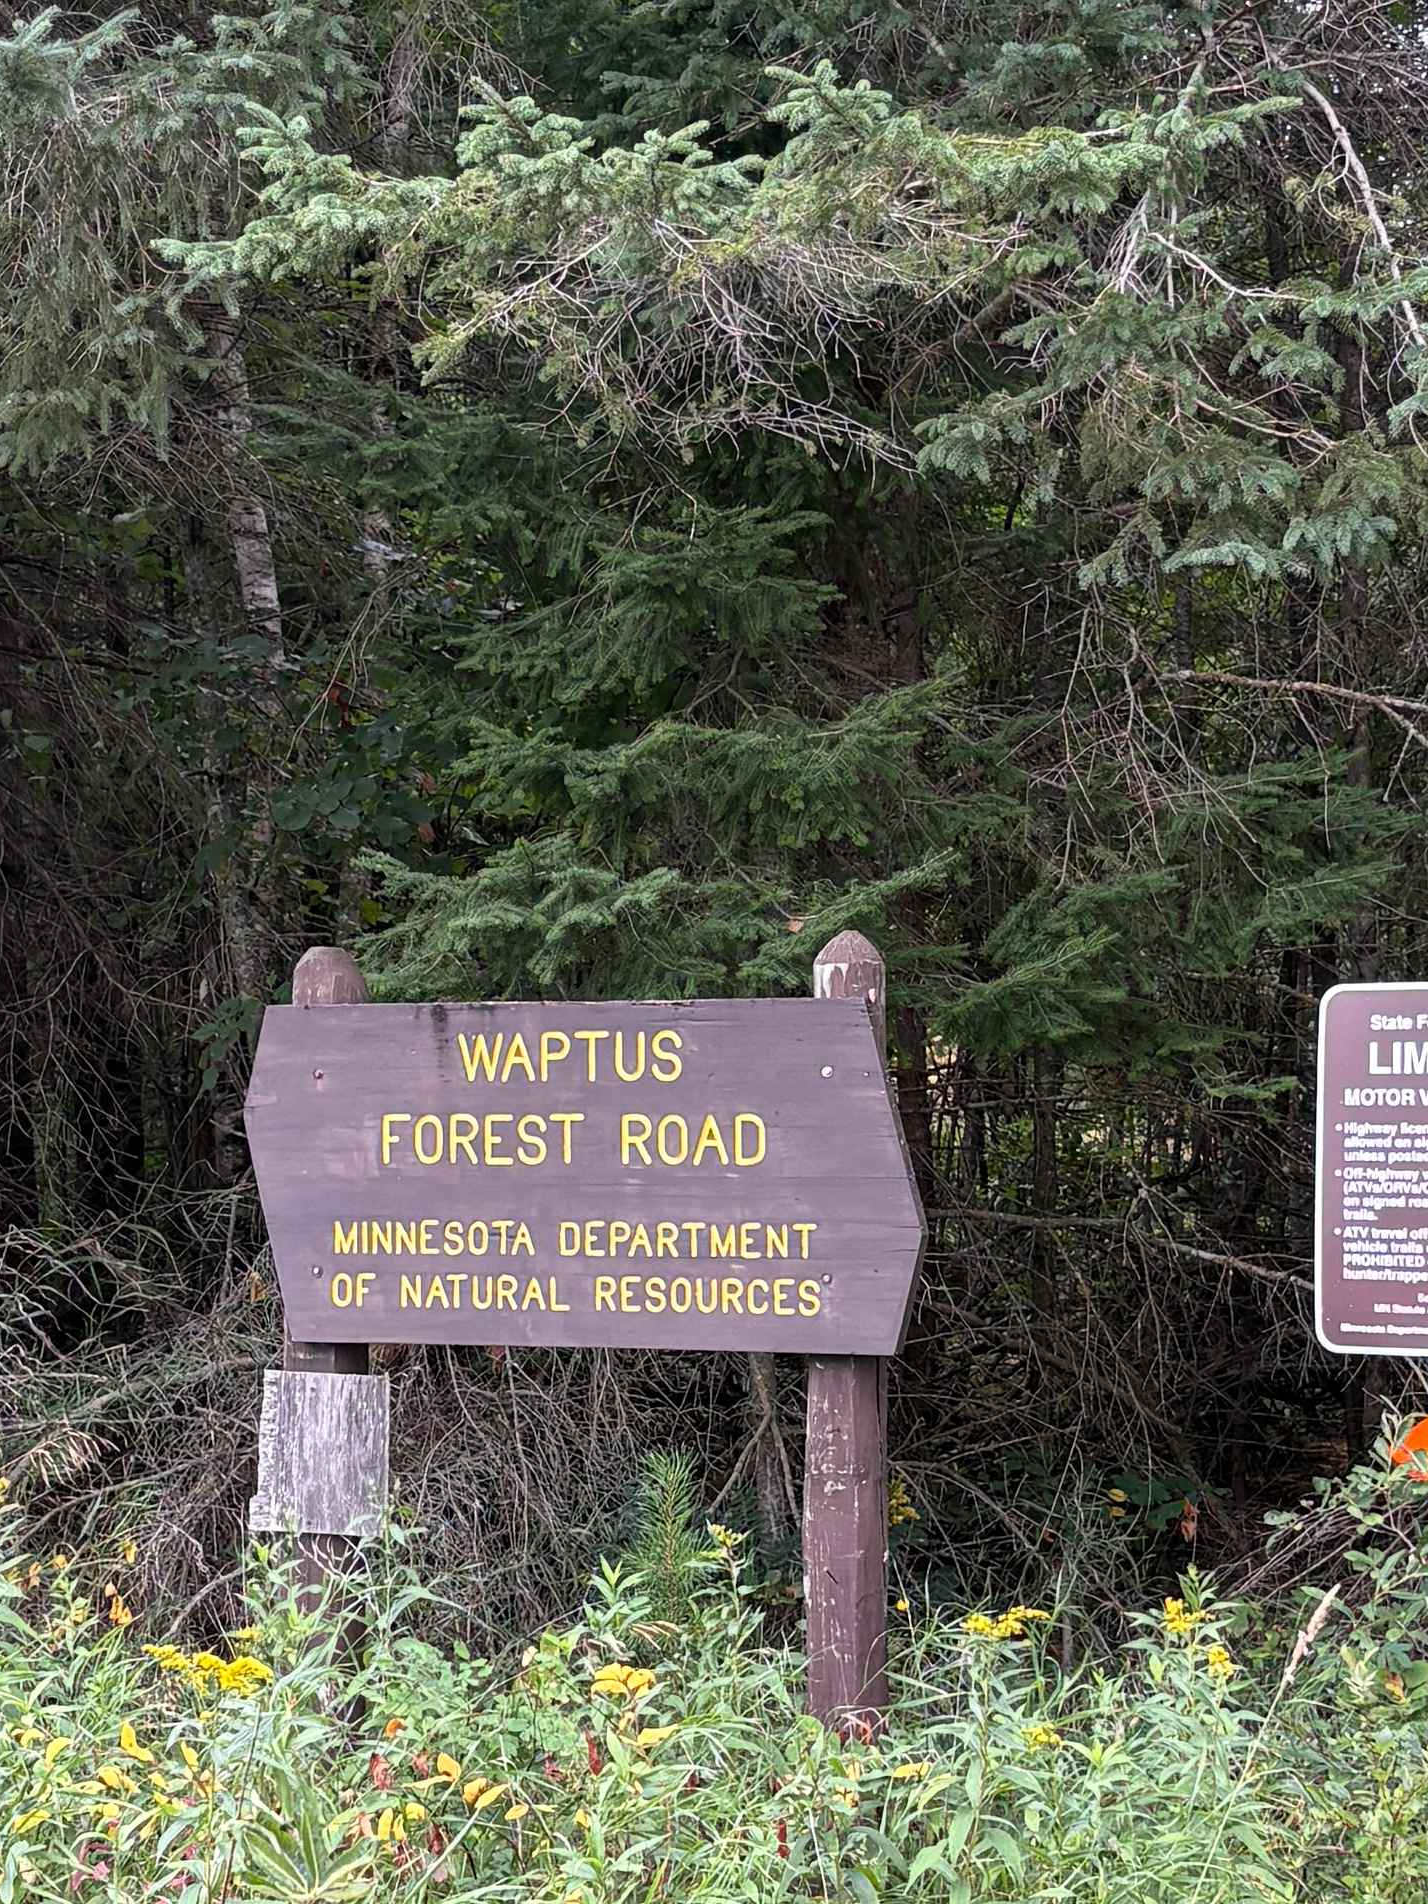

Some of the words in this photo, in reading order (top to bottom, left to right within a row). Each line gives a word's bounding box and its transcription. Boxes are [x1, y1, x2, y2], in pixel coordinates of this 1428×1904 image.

[1370, 1015, 1412, 1030] State
[457, 1030, 684, 1083] WAPTUS
[1344, 1088, 1415, 1106] MOTOR
[1344, 1122, 1397, 1137] Highway
[381, 1113, 584, 1166] FOREST
[620, 1113, 767, 1167] ROAD
[1344, 1135, 1392, 1148] allowed
[1395, 1138, 1412, 1148] on
[1344, 1150, 1385, 1162] unless
[1344, 1167, 1419, 1182] Off-highway
[1343, 1197, 1360, 1207] on
[1362, 1196, 1406, 1210] signed
[1343, 1208, 1378, 1221] trails.
[333, 1220, 535, 1257] MINNESOTA
[559, 1221, 817, 1260] DEPARTMENT
[1343, 1227, 1369, 1239] ATV
[1371, 1227, 1407, 1240] travel
[1410, 1228, 1428, 1240] off
[1343, 1240, 1387, 1253] vehicle
[1390, 1241, 1423, 1254] trails
[1343, 1253, 1425, 1268] PROHIBITED
[330, 1272, 376, 1308] OF
[399, 1275, 570, 1313] NATURAL
[594, 1277, 821, 1317] RESOURCES
